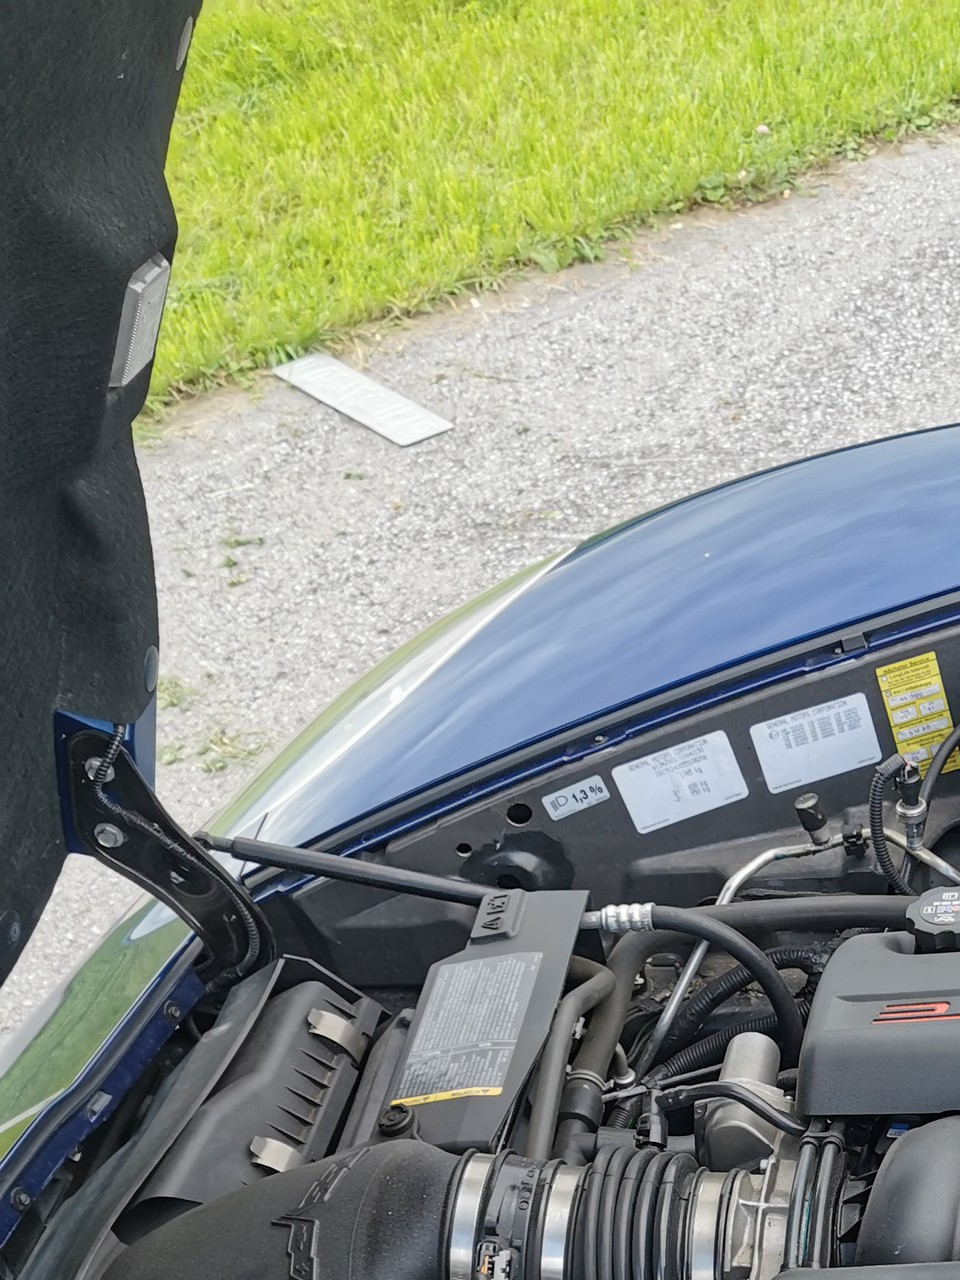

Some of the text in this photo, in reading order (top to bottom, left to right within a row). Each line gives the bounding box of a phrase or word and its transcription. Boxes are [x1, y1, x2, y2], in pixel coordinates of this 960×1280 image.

[765, 699, 847, 730] GENERAL MOTORS CORPORATION
[627, 738, 708, 772] GENERAL MOTORS CORPORATION
[572, 789, 588, 804] 1,3
[589, 784, 603, 795] %
